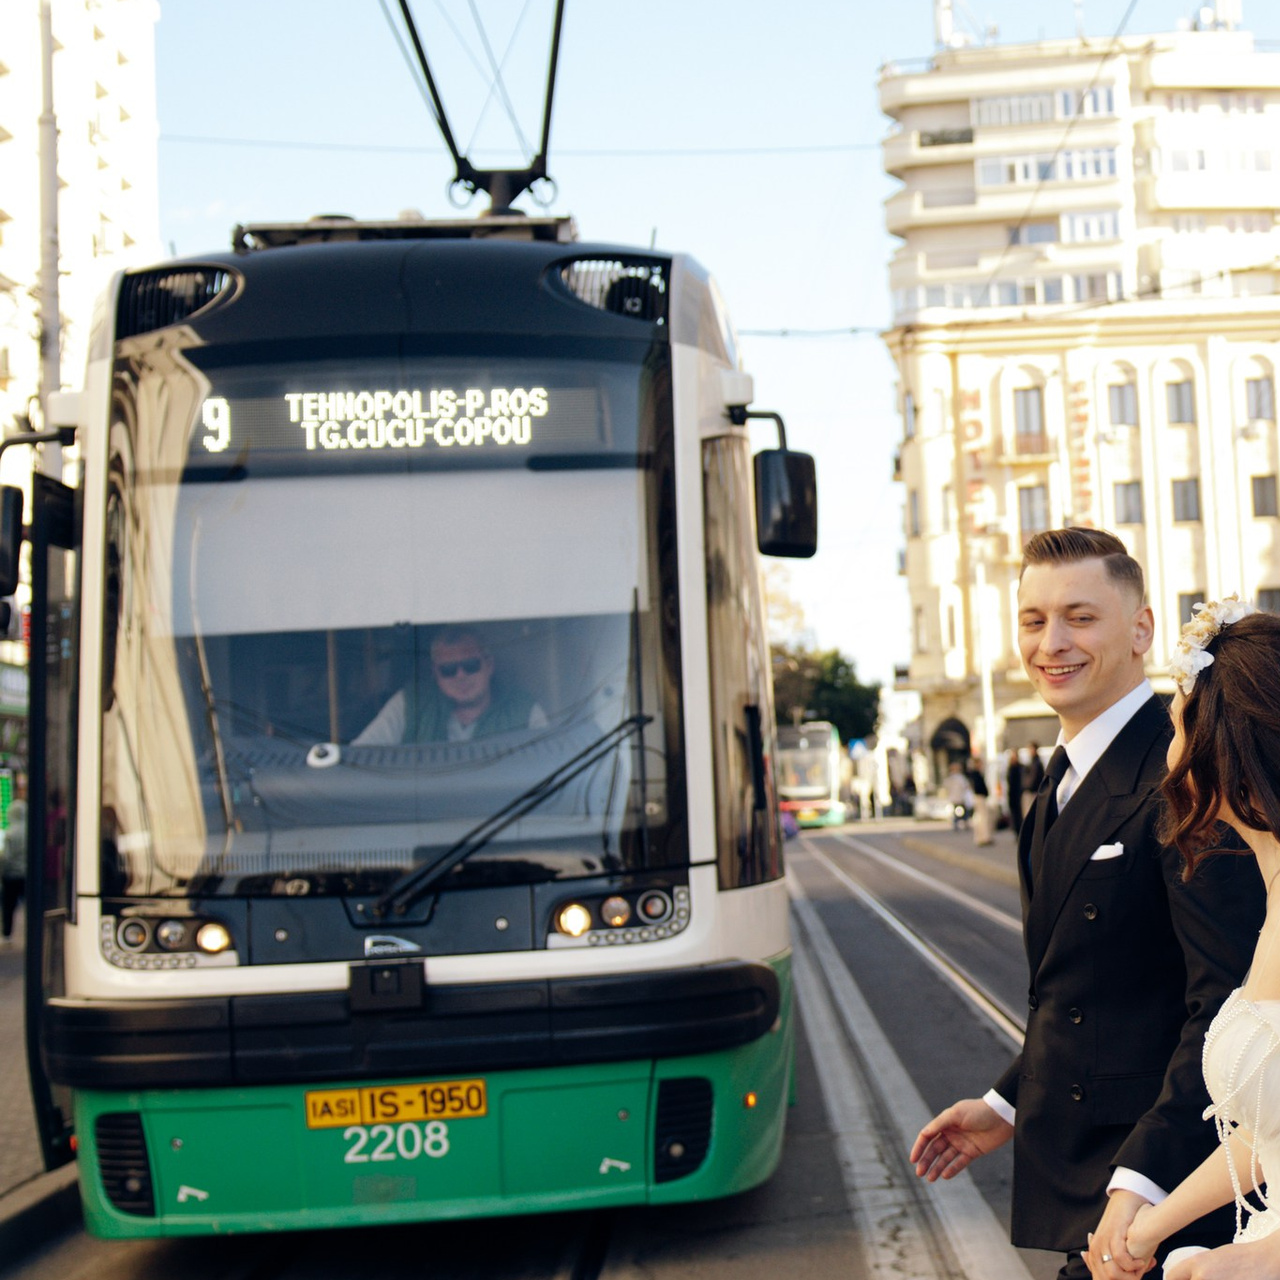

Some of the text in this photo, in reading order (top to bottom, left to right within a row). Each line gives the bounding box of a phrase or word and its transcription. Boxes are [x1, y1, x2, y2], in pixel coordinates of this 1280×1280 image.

[203, 397, 231, 453] 9
[301, 416, 531, 450] TG.CUCU-COPOU
[312, 1099, 356, 1119] IASI
[343, 1121, 450, 1163] 2208
